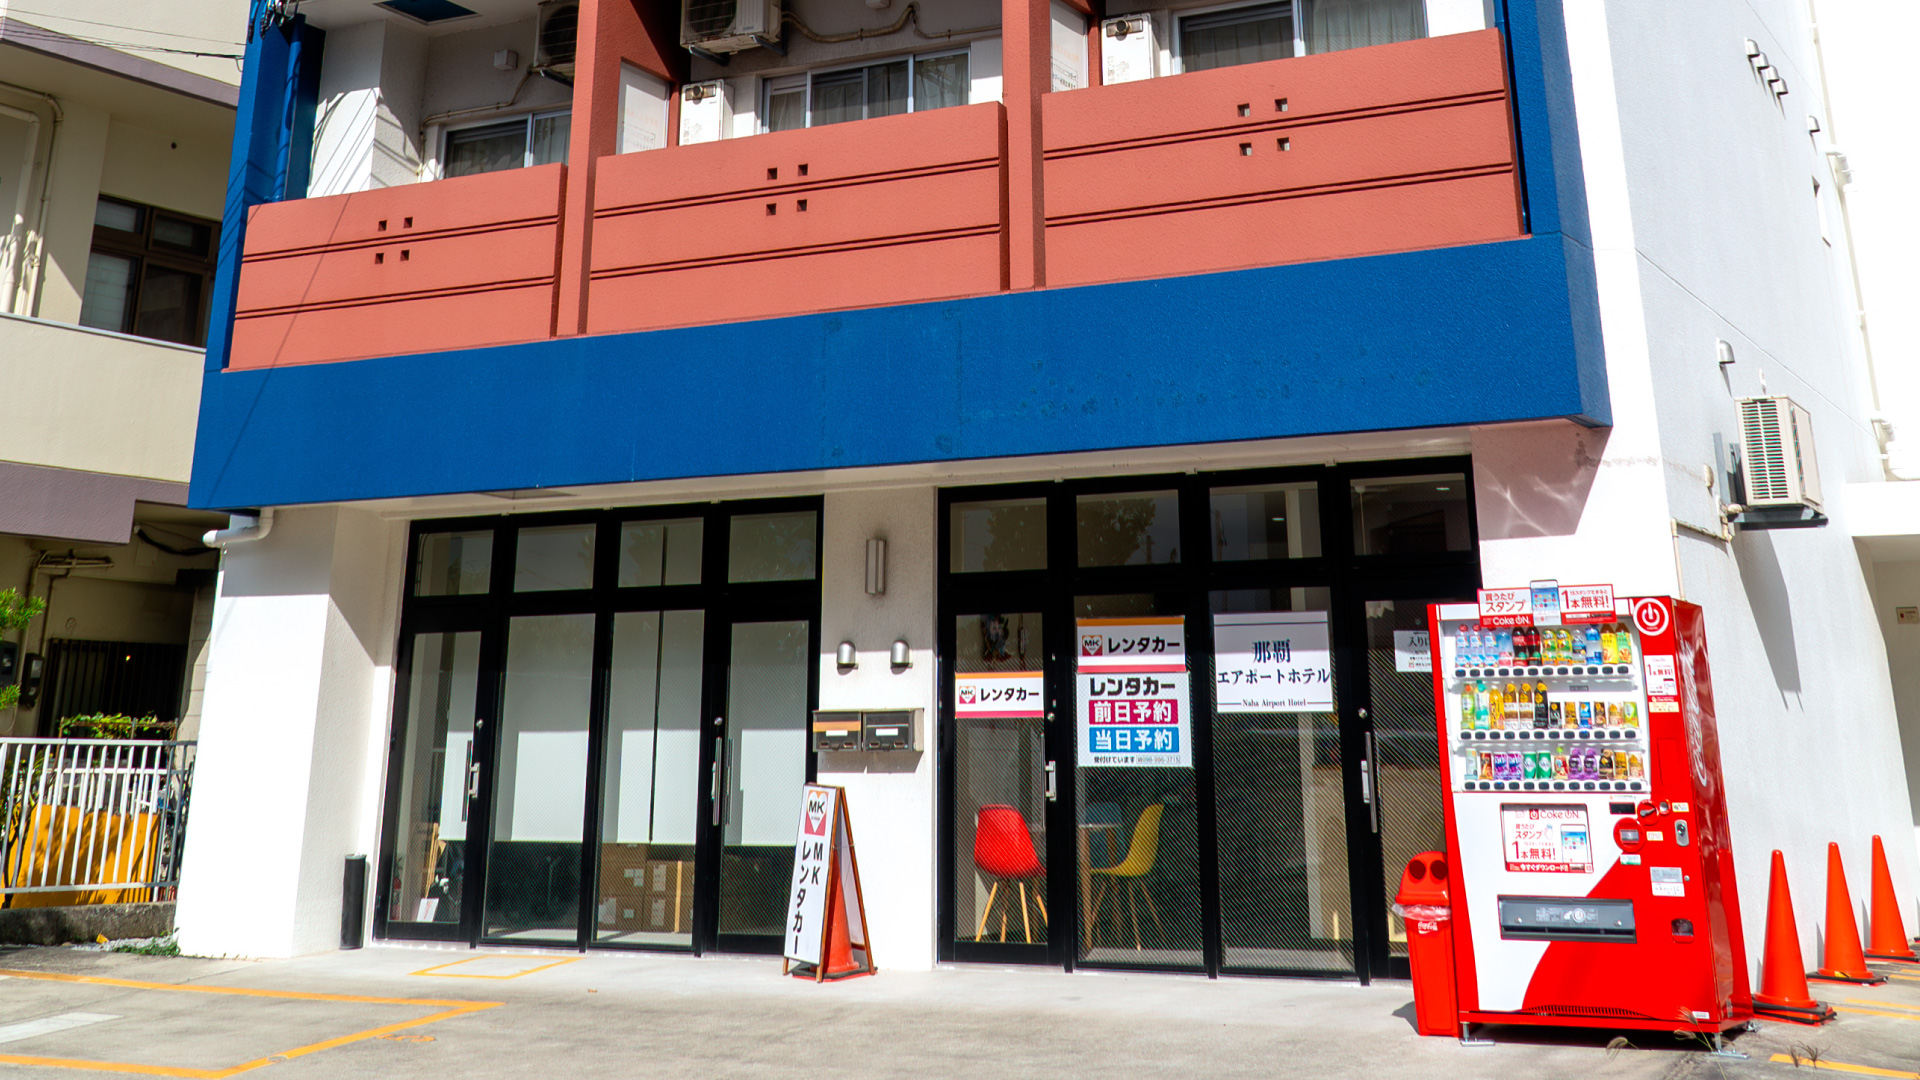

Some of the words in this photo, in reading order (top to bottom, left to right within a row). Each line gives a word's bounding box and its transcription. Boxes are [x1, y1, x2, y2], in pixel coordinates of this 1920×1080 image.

[1485, 592, 1514, 602] 買うたび
[1485, 599, 1526, 613] スタンプ
[1492, 616, 1514, 626] Coke
[1084, 639, 1100, 647] MK
[1108, 636, 1181, 654] レンタカー
[1252, 638, 1291, 663] 那覇
[1217, 668, 1331, 684] エアポートホテル
[980, 686, 1040, 702] レンタカー
[1090, 676, 1176, 696] レンタカー
[1242, 699, 1259, 707] Naha
[1262, 699, 1286, 708] Airport
[1288, 698, 1306, 707] Hotel
[1094, 701, 1172, 723] 前日予約
[1095, 729, 1173, 751] 当日予約
[808, 799, 825, 814] MK
[1540, 809, 1563, 819] Coke
[1515, 829, 1543, 839] スタンプ
[811, 842, 824, 885] MK
[792, 840, 812, 955] レンタカー
